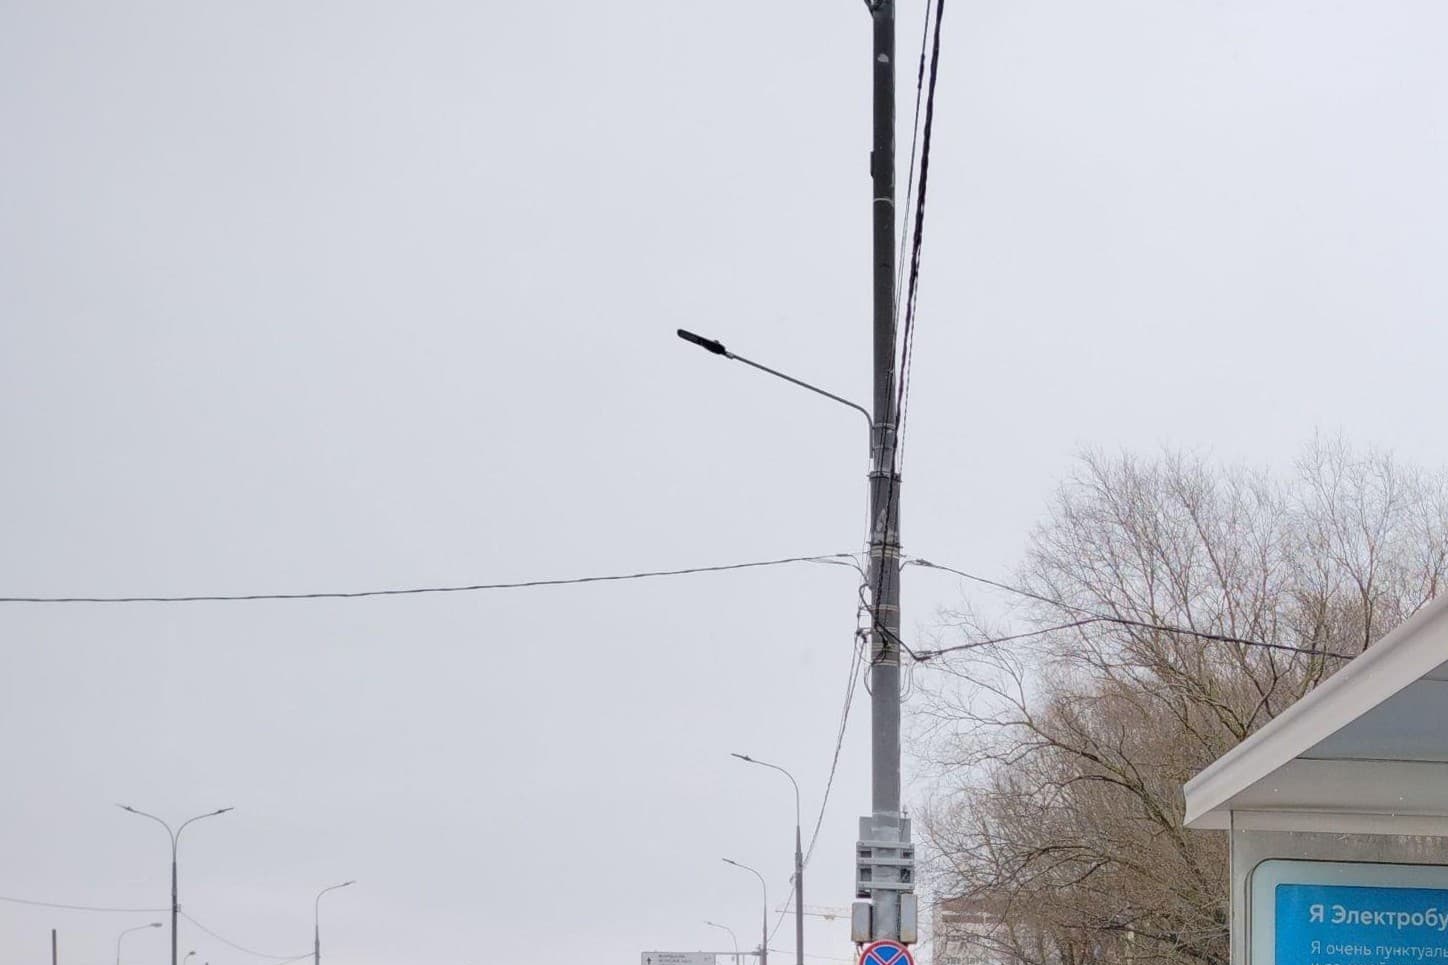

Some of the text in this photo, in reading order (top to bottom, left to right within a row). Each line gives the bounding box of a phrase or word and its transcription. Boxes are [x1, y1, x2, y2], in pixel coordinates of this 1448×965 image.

[1309, 904, 1325, 923] Я
[1311, 940, 1322, 955] Я
[1326, 943, 1372, 957] очень
